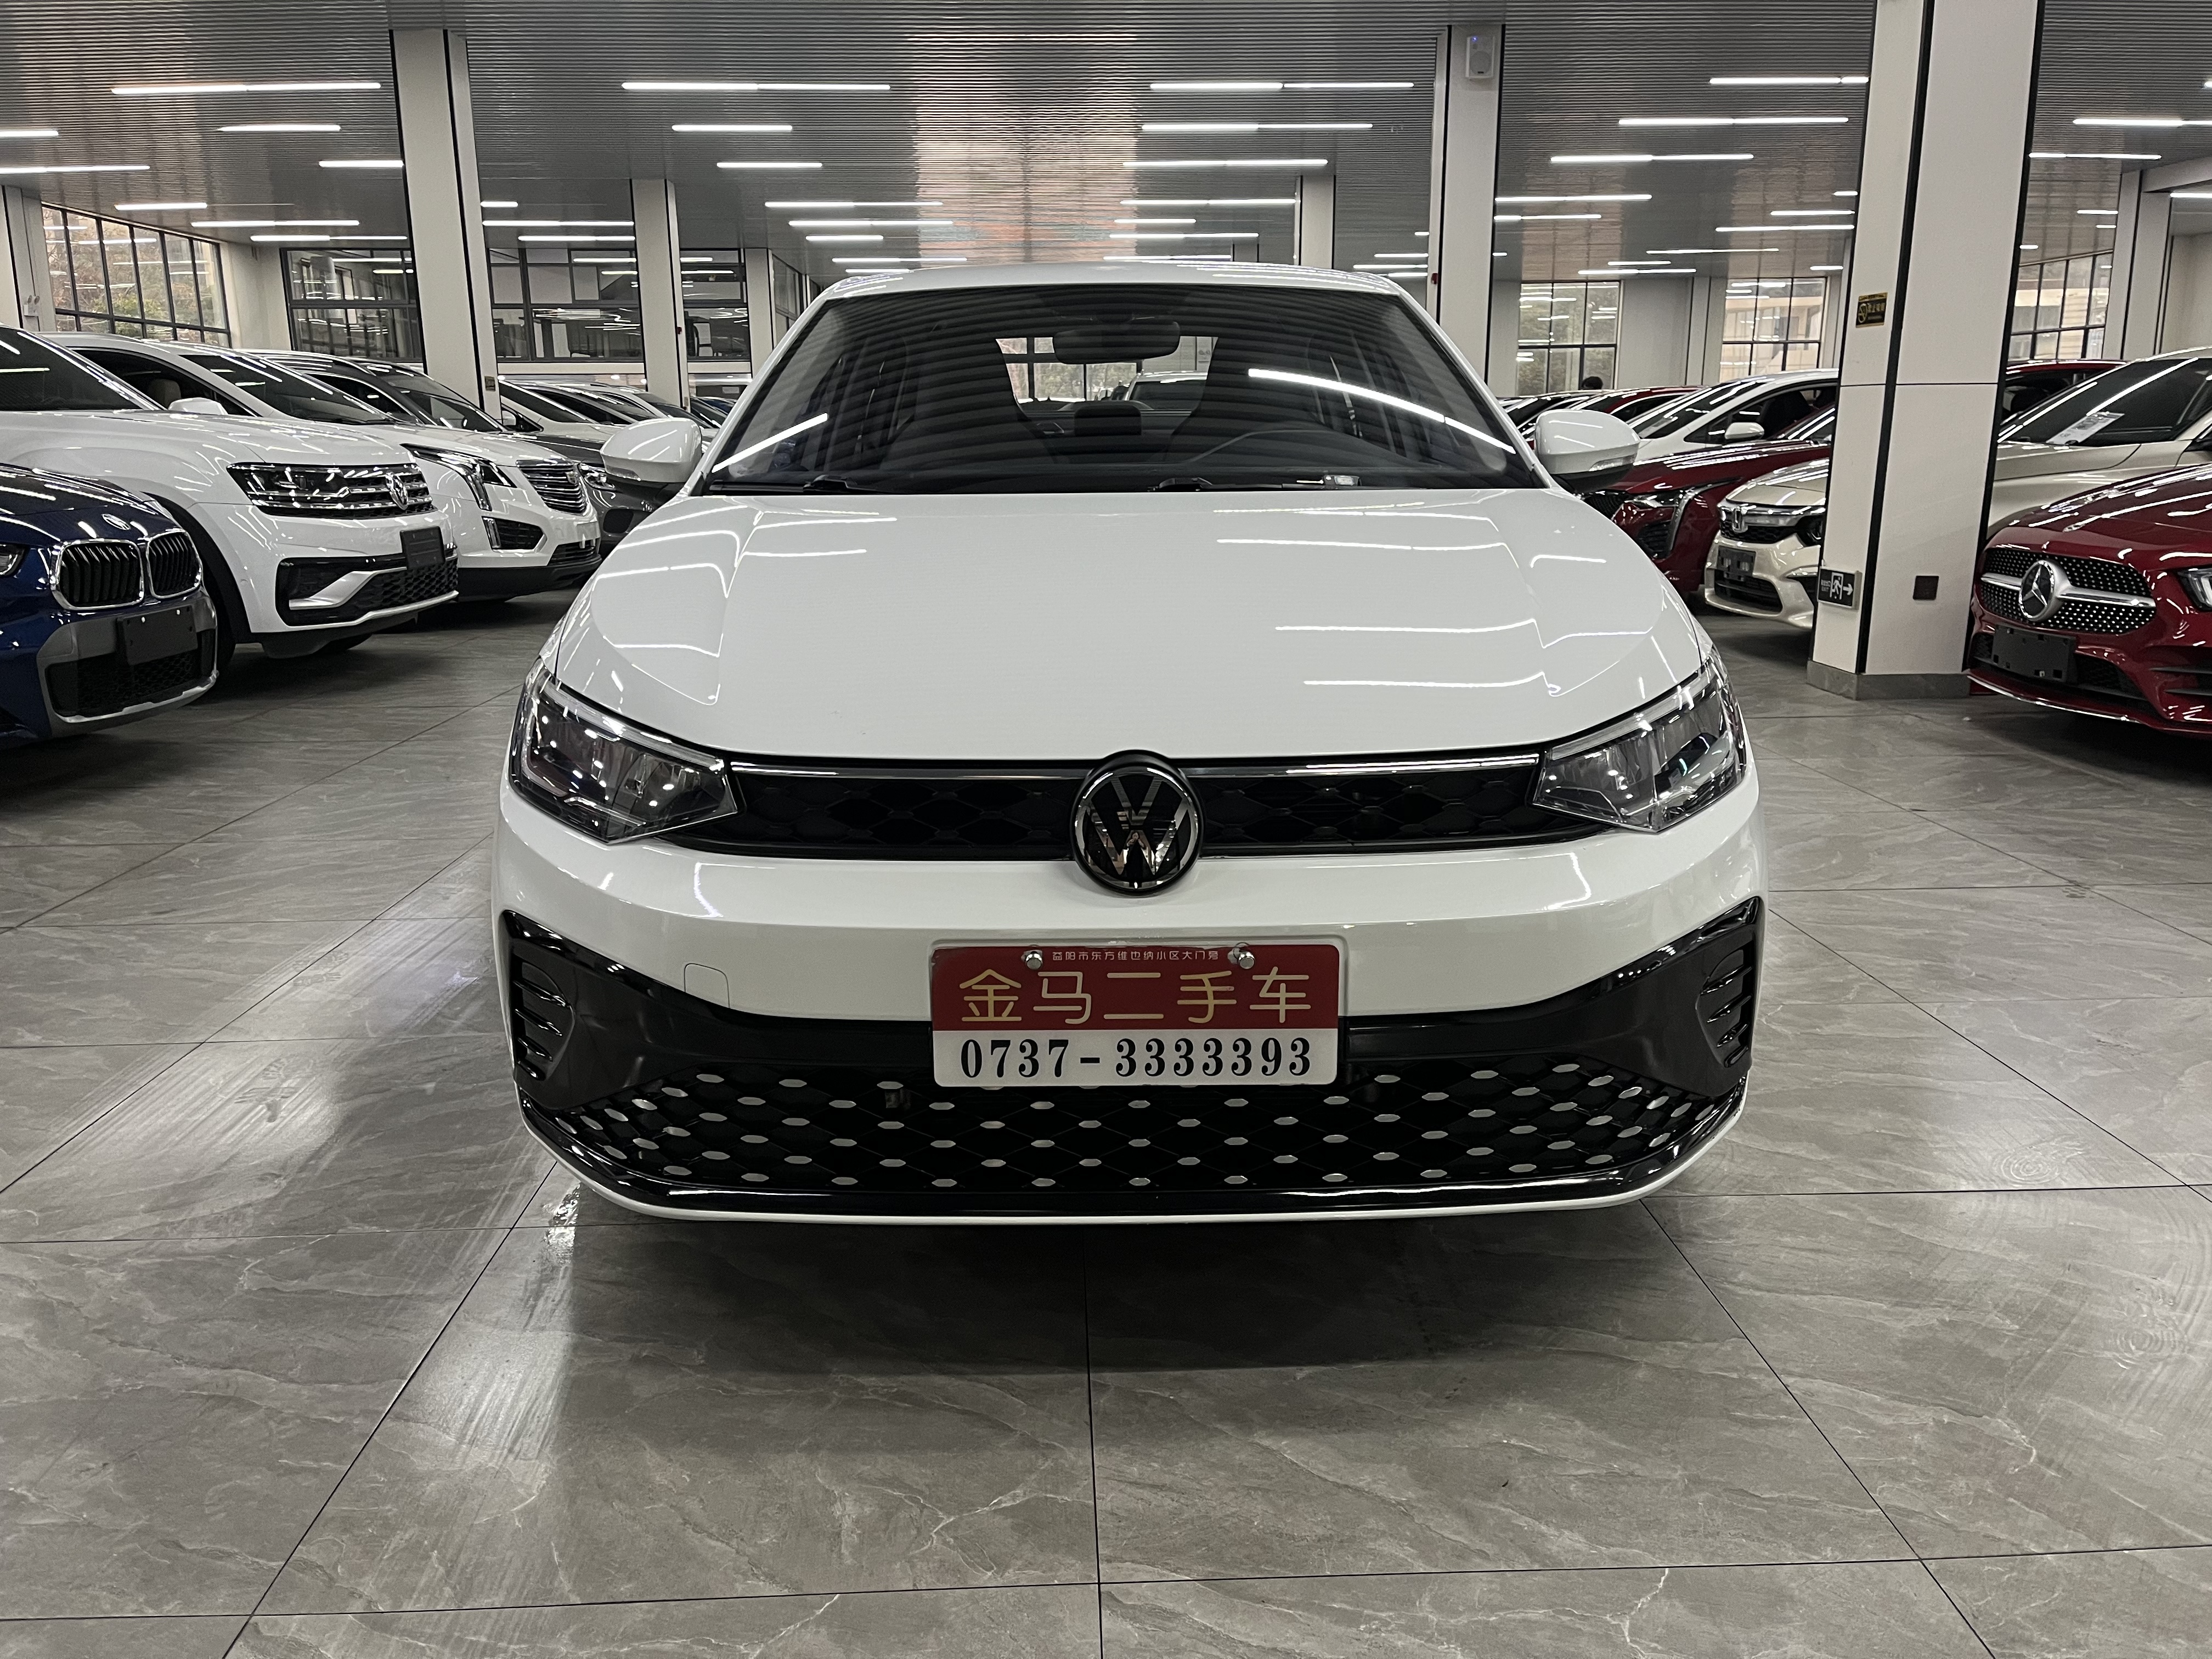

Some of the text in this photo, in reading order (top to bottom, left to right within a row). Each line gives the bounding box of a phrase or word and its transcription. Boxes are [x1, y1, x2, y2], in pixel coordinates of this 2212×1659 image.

[1052, 951, 1219, 961] 益阳市东方维也纳小区大门旁
[959, 968, 1311, 1024] 金马二手车
[960, 1037, 1311, 1078] 0737-3333393
